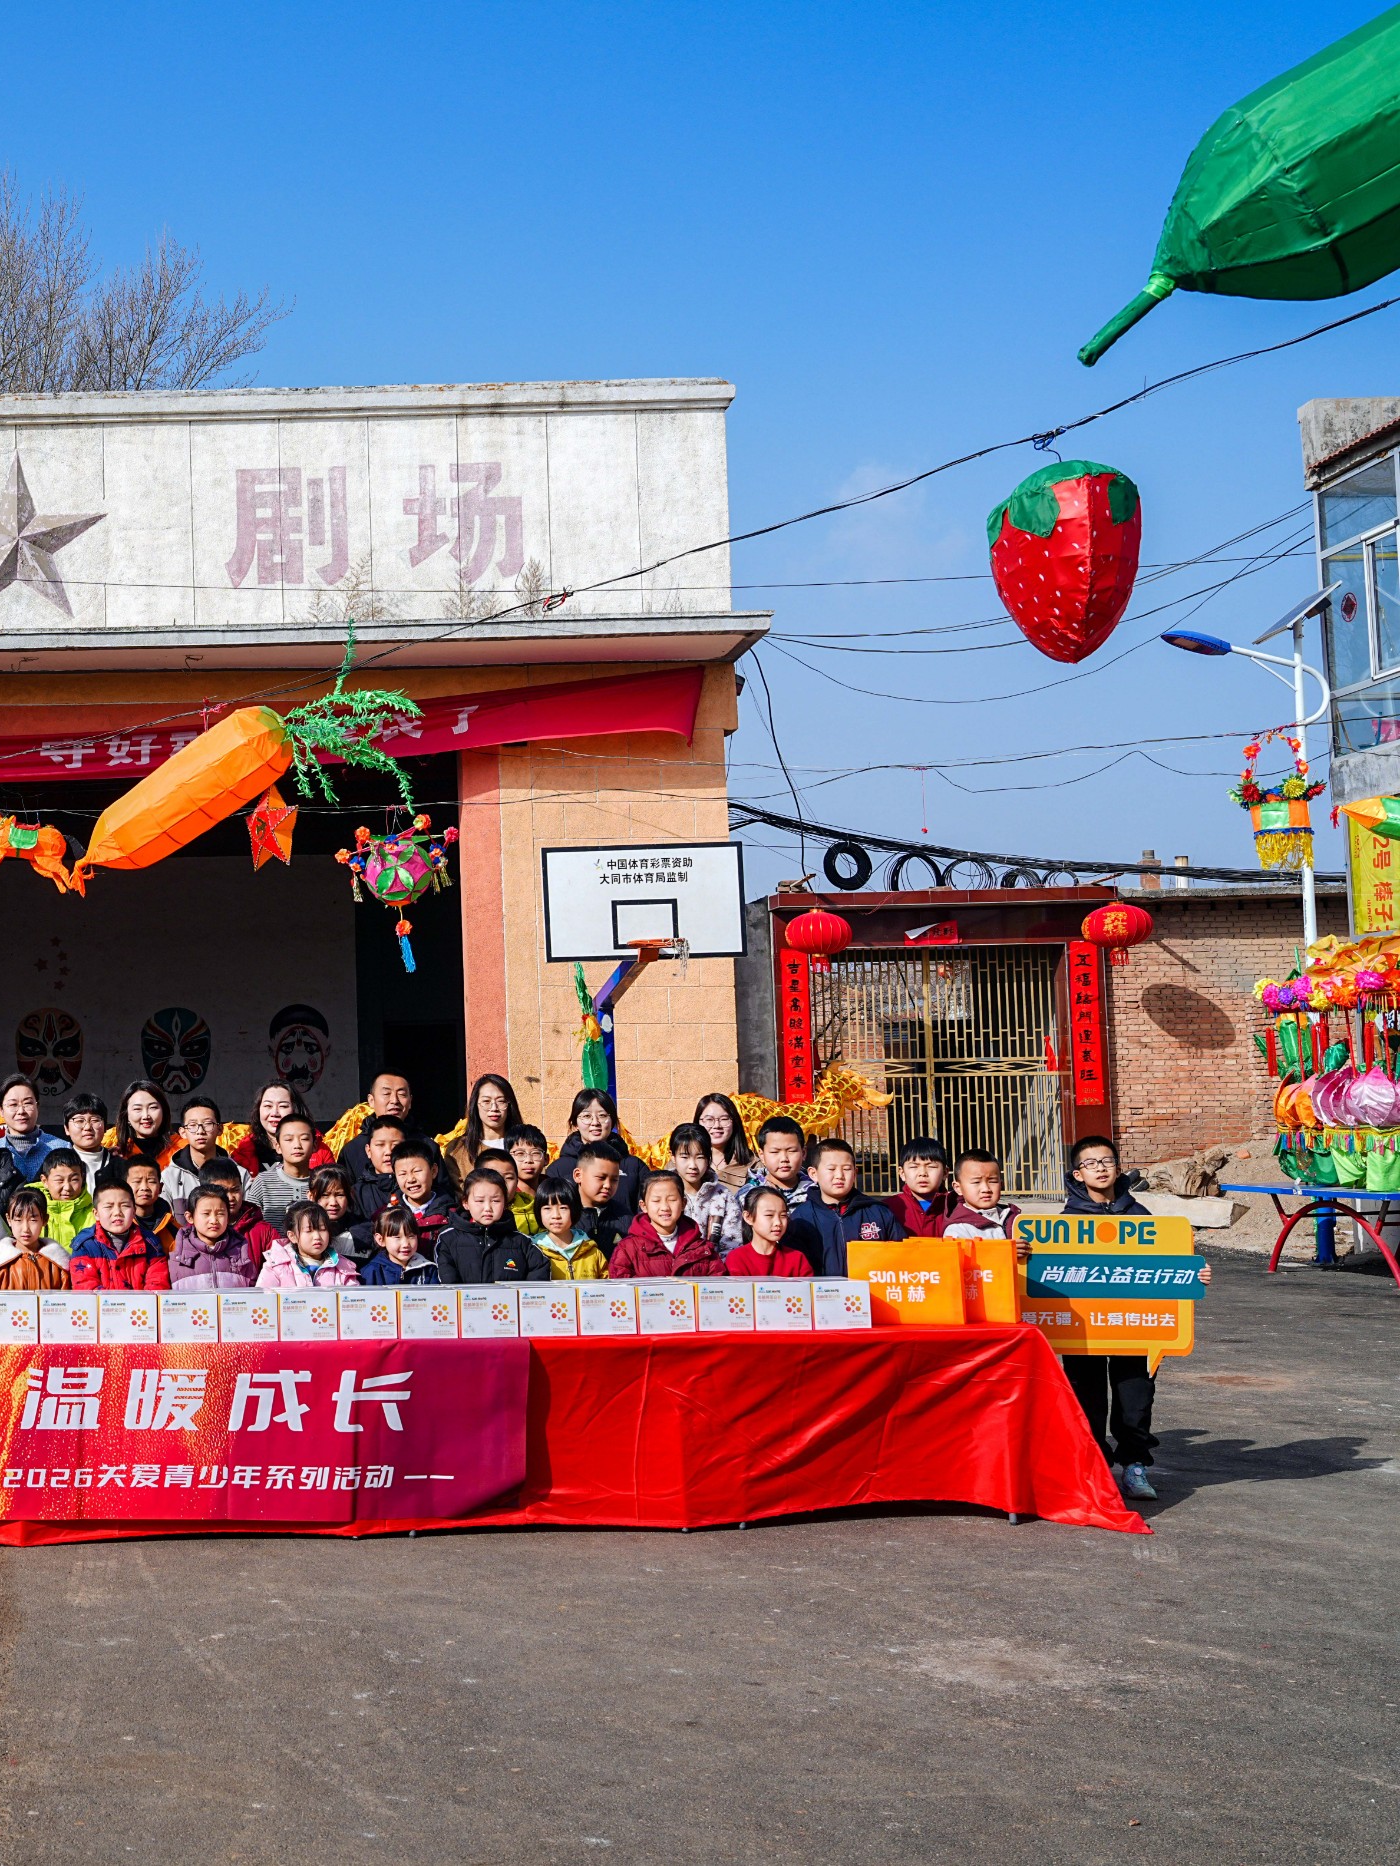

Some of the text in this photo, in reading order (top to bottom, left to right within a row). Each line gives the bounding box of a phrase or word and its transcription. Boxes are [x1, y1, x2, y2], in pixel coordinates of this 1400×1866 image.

[224, 461, 525, 589] 剧场
[606, 856, 693, 870] 中国体育彩票资助
[599, 871, 688, 885] 大同市体育局监制
[1017, 1219, 1157, 1245] SUN HOPE
[868, 1270, 941, 1284] SUN HOPE
[1040, 1265, 1195, 1285] 尚赫公益在行动
[886, 1284, 926, 1303] 尚赫
[1021, 1311, 1176, 1327] 爱无疆，让爱传出去
[2, 1463, 395, 1490] 2026关爱青少年系列活动
